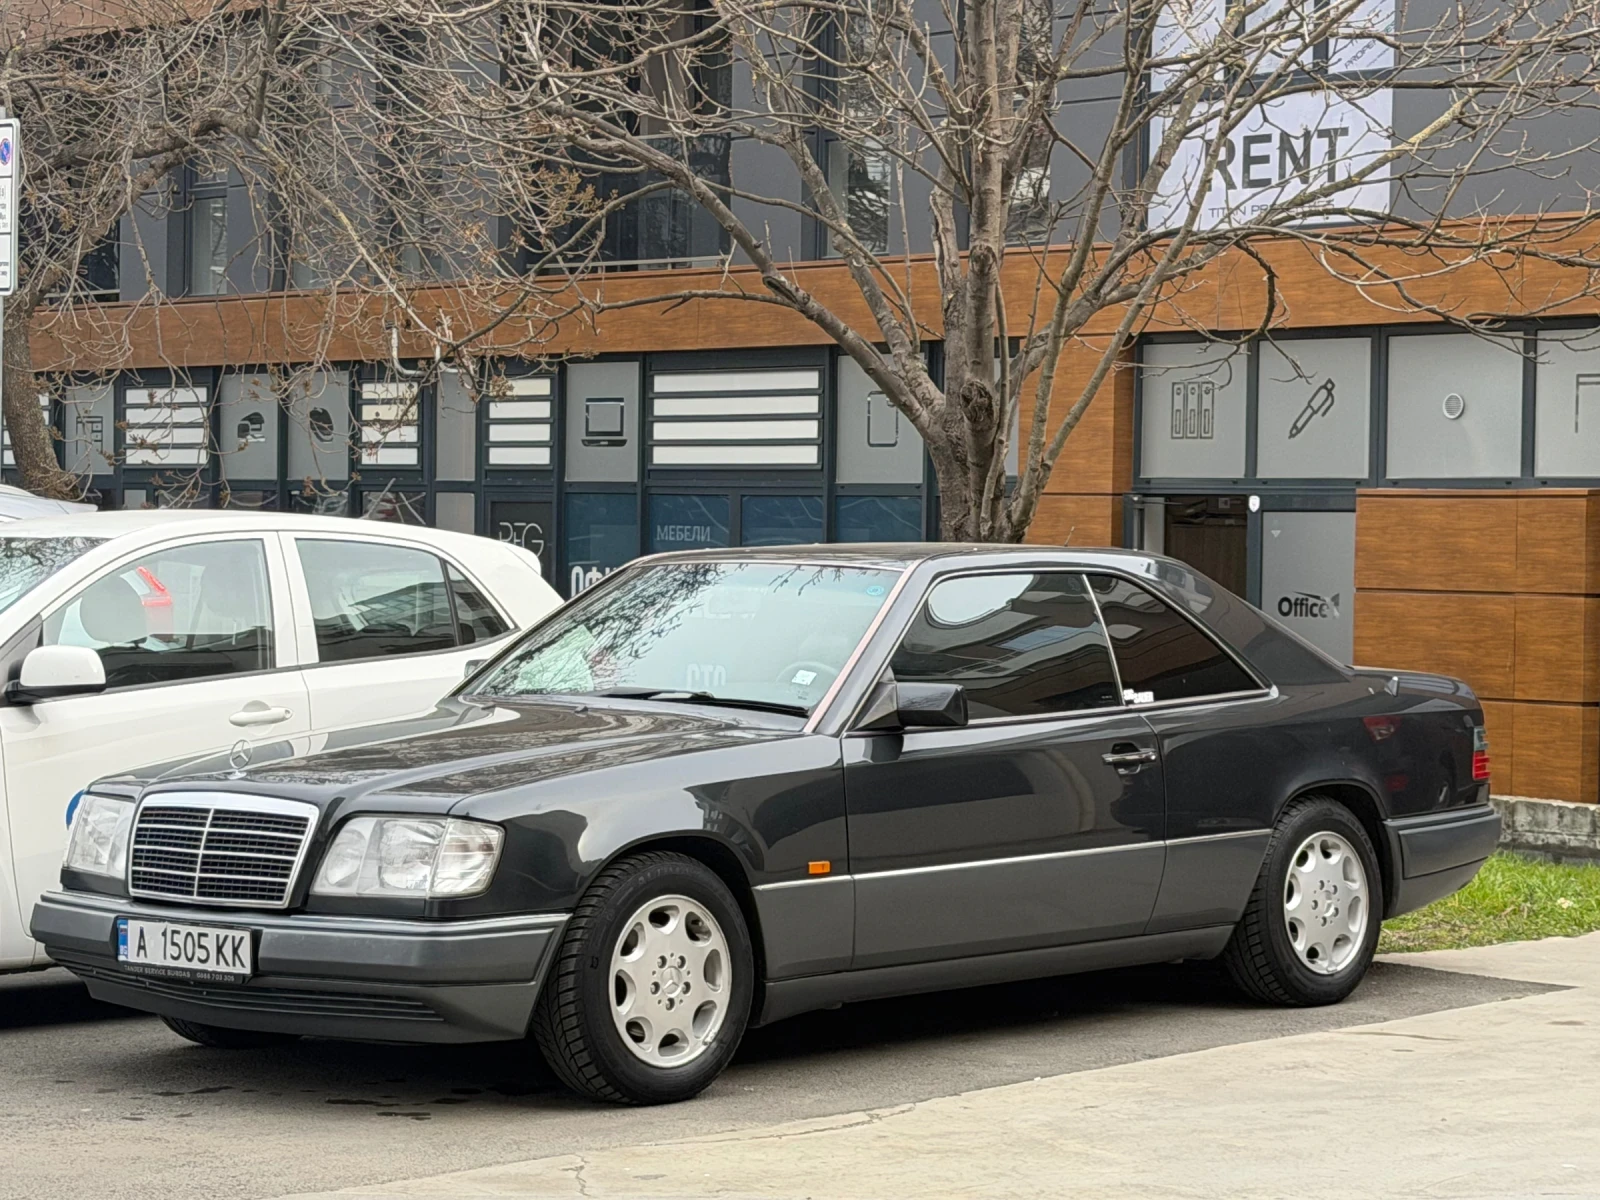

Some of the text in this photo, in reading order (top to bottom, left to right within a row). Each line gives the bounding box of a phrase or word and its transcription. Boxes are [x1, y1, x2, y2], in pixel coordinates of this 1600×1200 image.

[1205, 126, 1349, 192] RENT
[656, 524, 710, 542] МЕБЕЛИ
[136, 926, 148, 959] A
